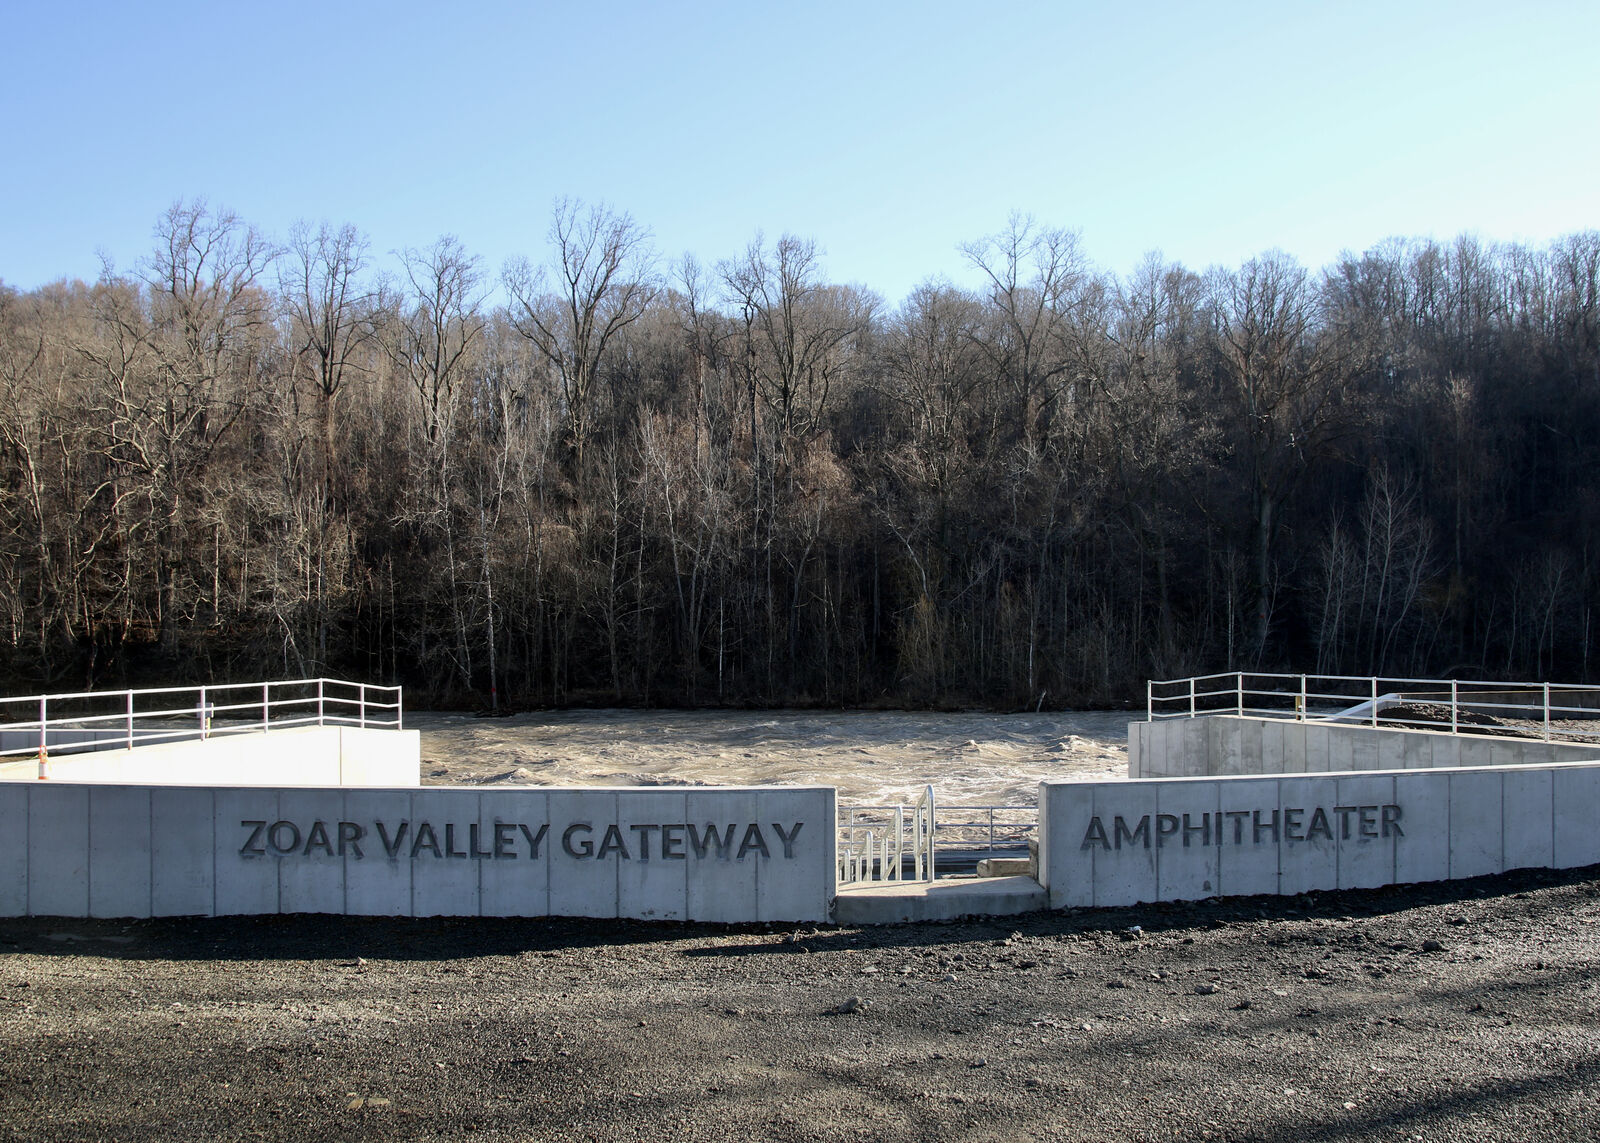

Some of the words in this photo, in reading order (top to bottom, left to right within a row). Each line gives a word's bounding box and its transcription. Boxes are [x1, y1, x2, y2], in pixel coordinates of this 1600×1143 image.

[239, 820, 364, 857] ZOAR
[376, 822, 550, 860] VALLEY
[562, 823, 804, 860] GATEWAY
[1080, 805, 1404, 850] AMPHITHEATER
